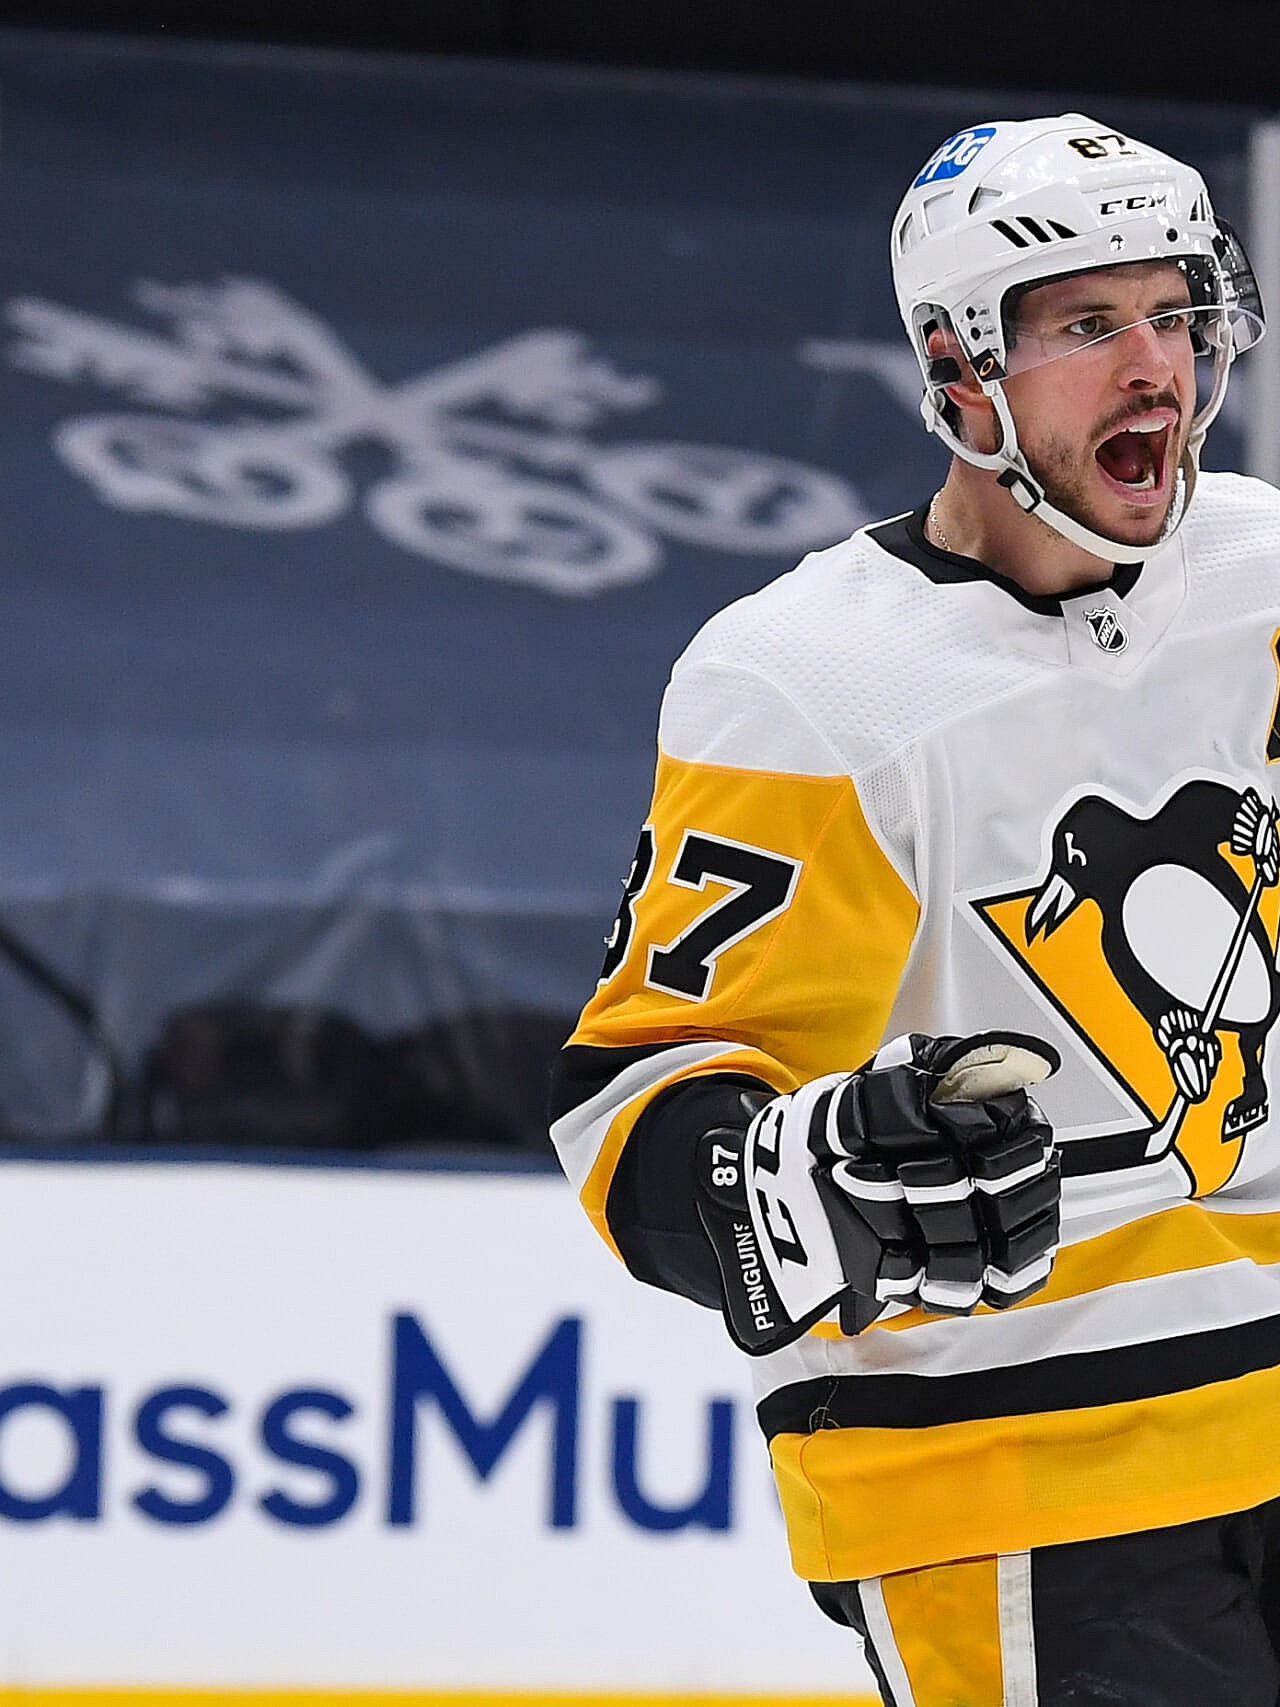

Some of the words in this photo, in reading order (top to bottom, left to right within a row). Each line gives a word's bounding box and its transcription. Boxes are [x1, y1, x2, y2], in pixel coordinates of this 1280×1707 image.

[919, 132, 991, 181] PPG
[1065, 134, 1138, 159] 87
[1099, 194, 1168, 215] CCM
[711, 1145, 740, 1187] 87
